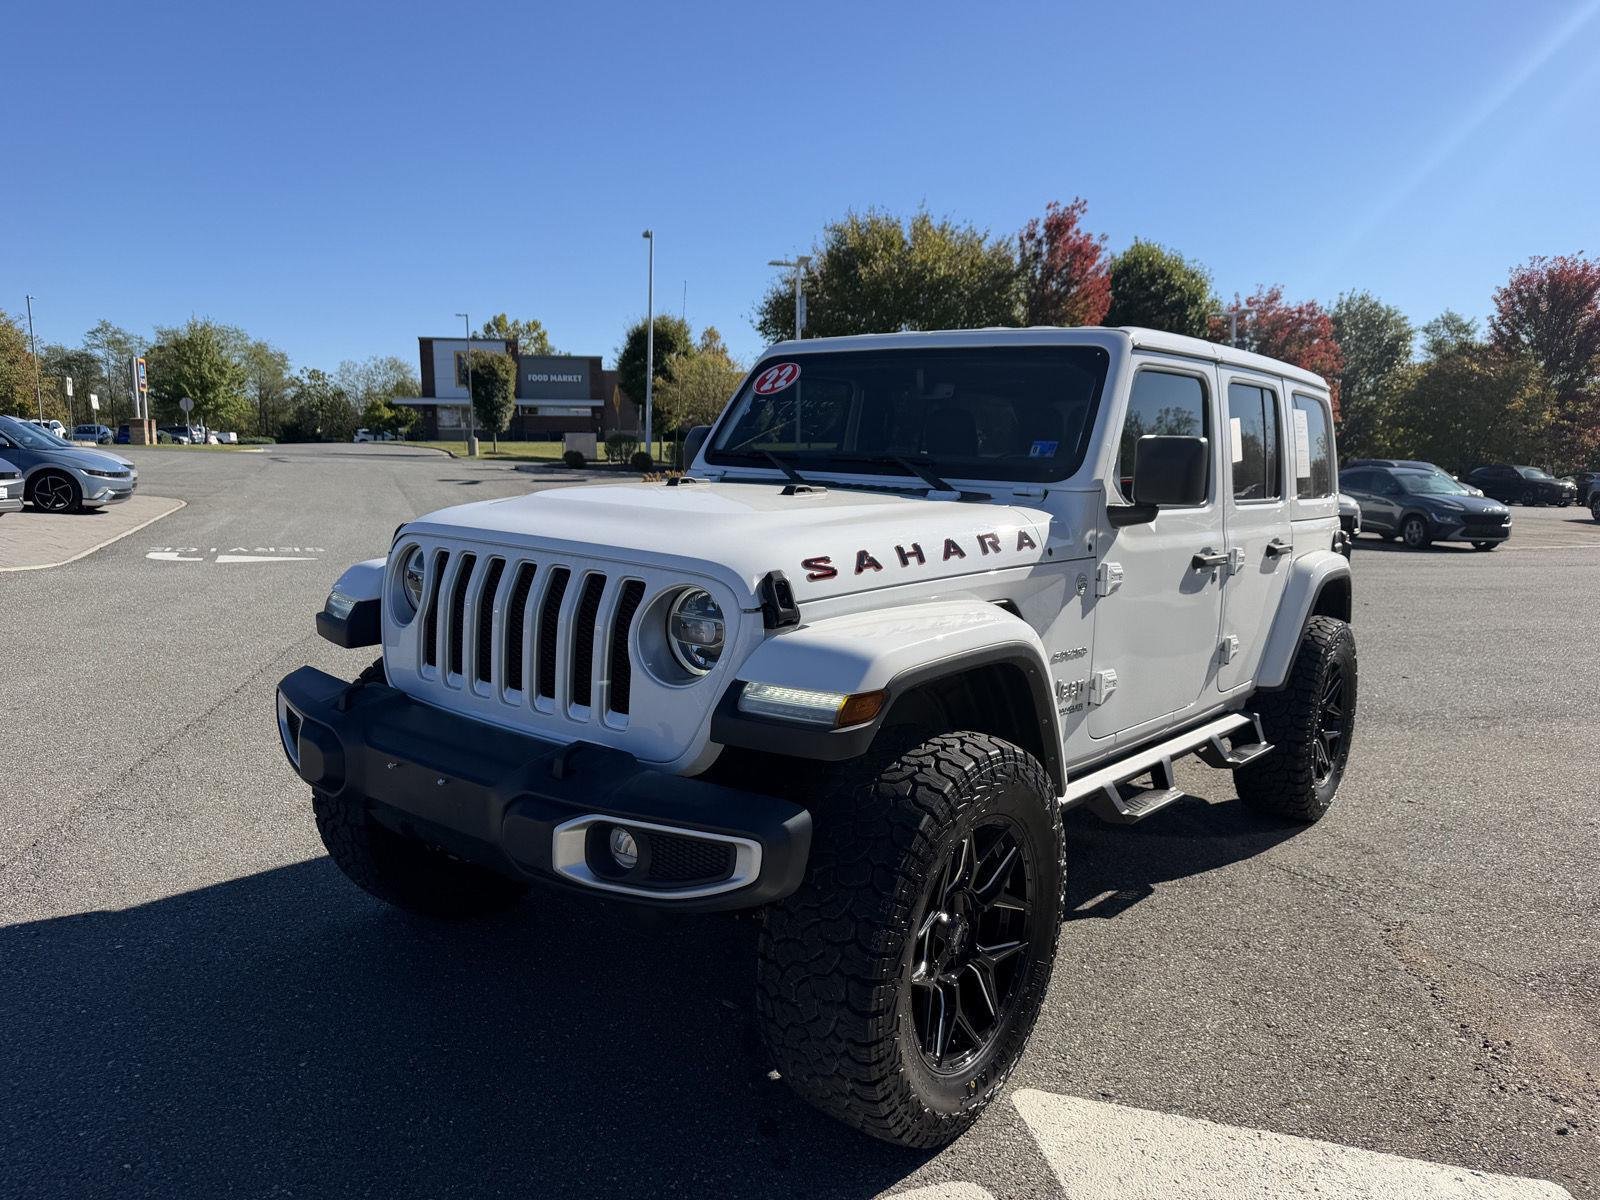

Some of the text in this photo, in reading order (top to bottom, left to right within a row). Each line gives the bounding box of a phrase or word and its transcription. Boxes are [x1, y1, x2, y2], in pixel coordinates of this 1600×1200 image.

[527, 374, 583, 383] FOOD MARKET
[760, 365, 794, 391] 22
[801, 530, 1037, 583] SAHARA
